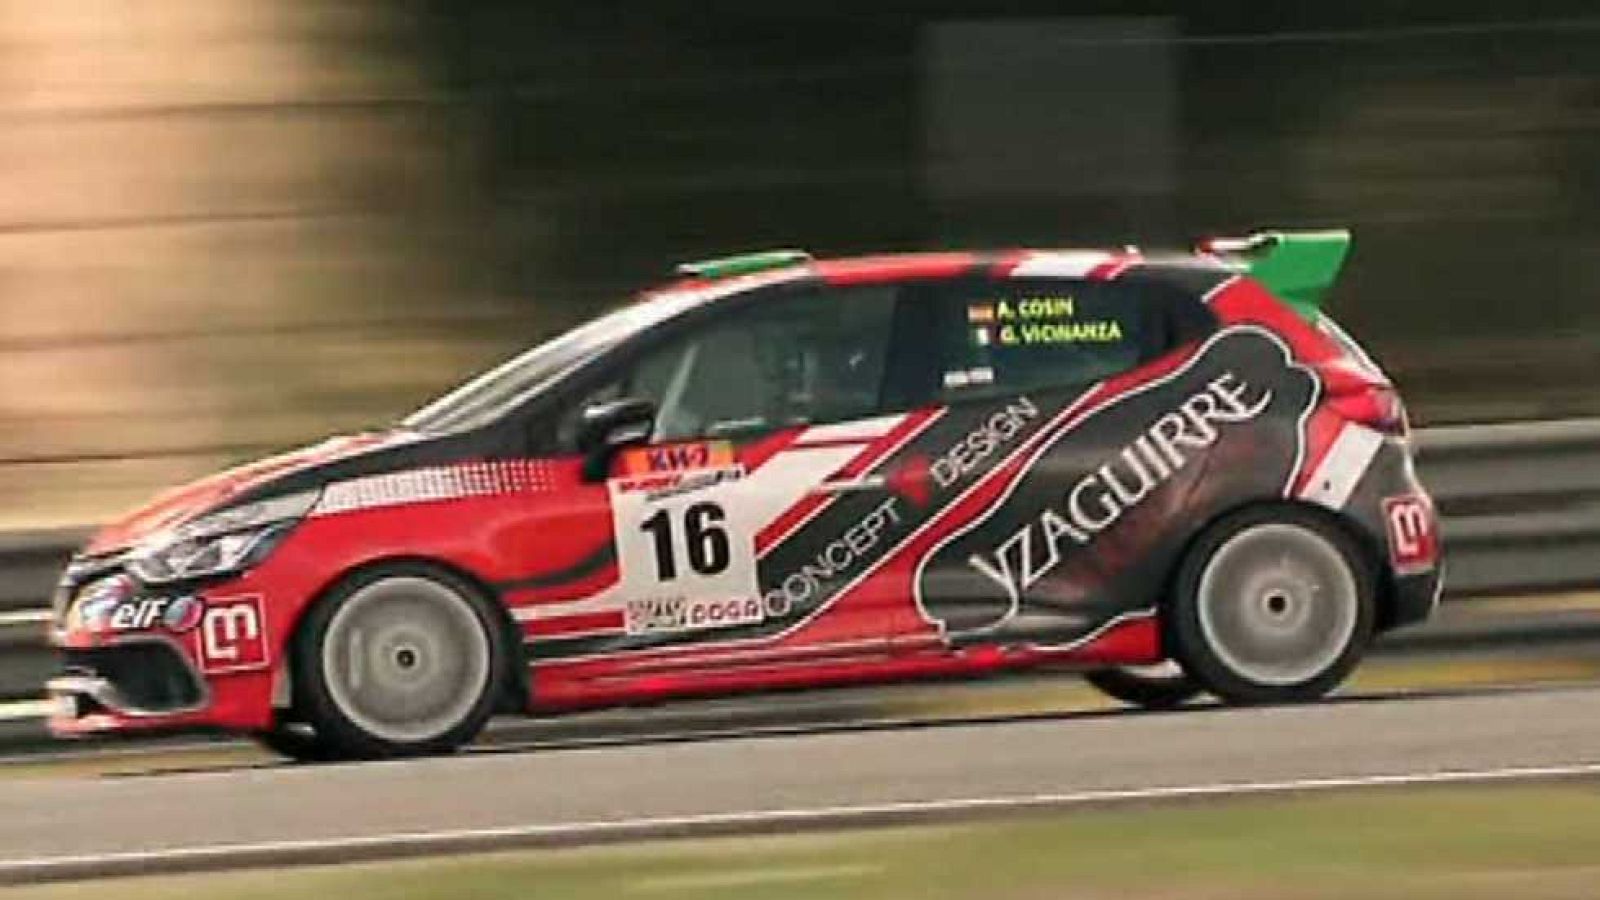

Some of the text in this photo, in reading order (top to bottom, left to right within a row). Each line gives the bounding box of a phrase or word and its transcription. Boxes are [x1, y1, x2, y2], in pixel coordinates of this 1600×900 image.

[998, 300, 1015, 318] A.
[1000, 325, 1019, 344] G.
[930, 396, 1039, 488] DESIGN
[970, 371, 1273, 606] YZAGUIRRE
[639, 500, 731, 582] 16
[763, 496, 900, 617] CONCEPT
